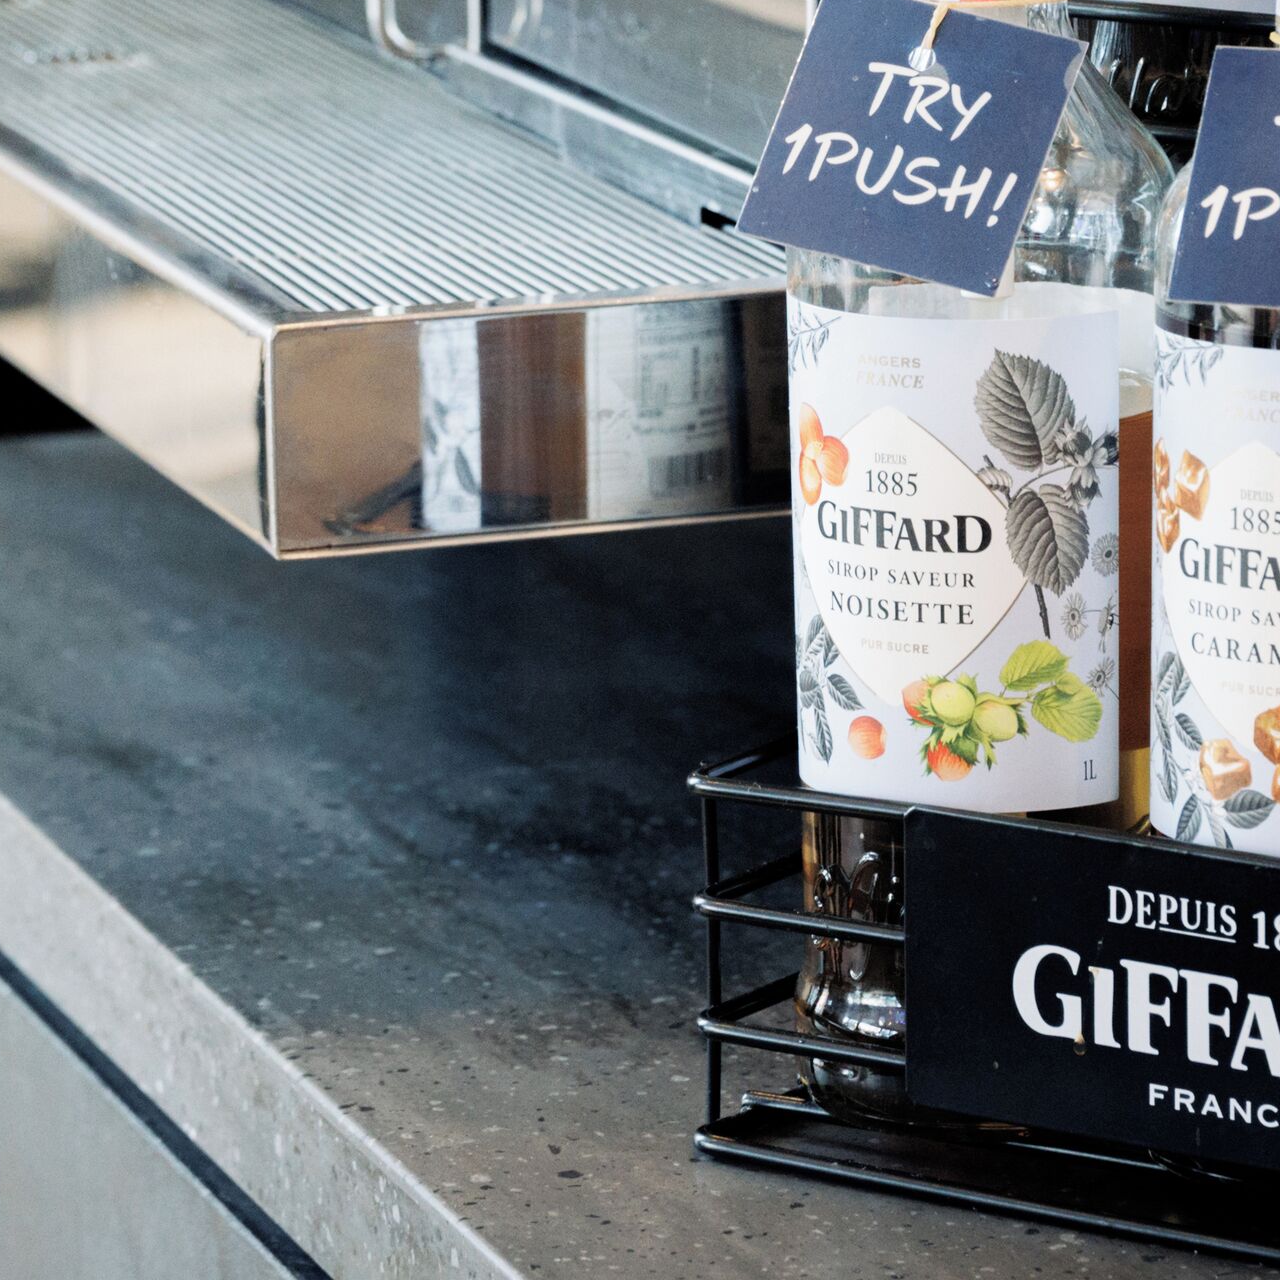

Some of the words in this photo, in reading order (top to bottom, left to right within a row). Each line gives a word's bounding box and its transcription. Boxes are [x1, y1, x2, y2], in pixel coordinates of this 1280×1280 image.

[868, 61, 992, 141] TRY
[782, 123, 1018, 227] 1PUSH!
[866, 469, 917, 497] 1885
[817, 500, 992, 553] GIFFARD
[828, 559, 878, 581] SIROP
[888, 569, 976, 588] SAVEUR
[830, 591, 974, 625] NOISETTE
[1189, 598, 1241, 622] SIROP
[887, 641, 929, 654] SUCRE
[1108, 885, 1237, 943] DEPUIS
